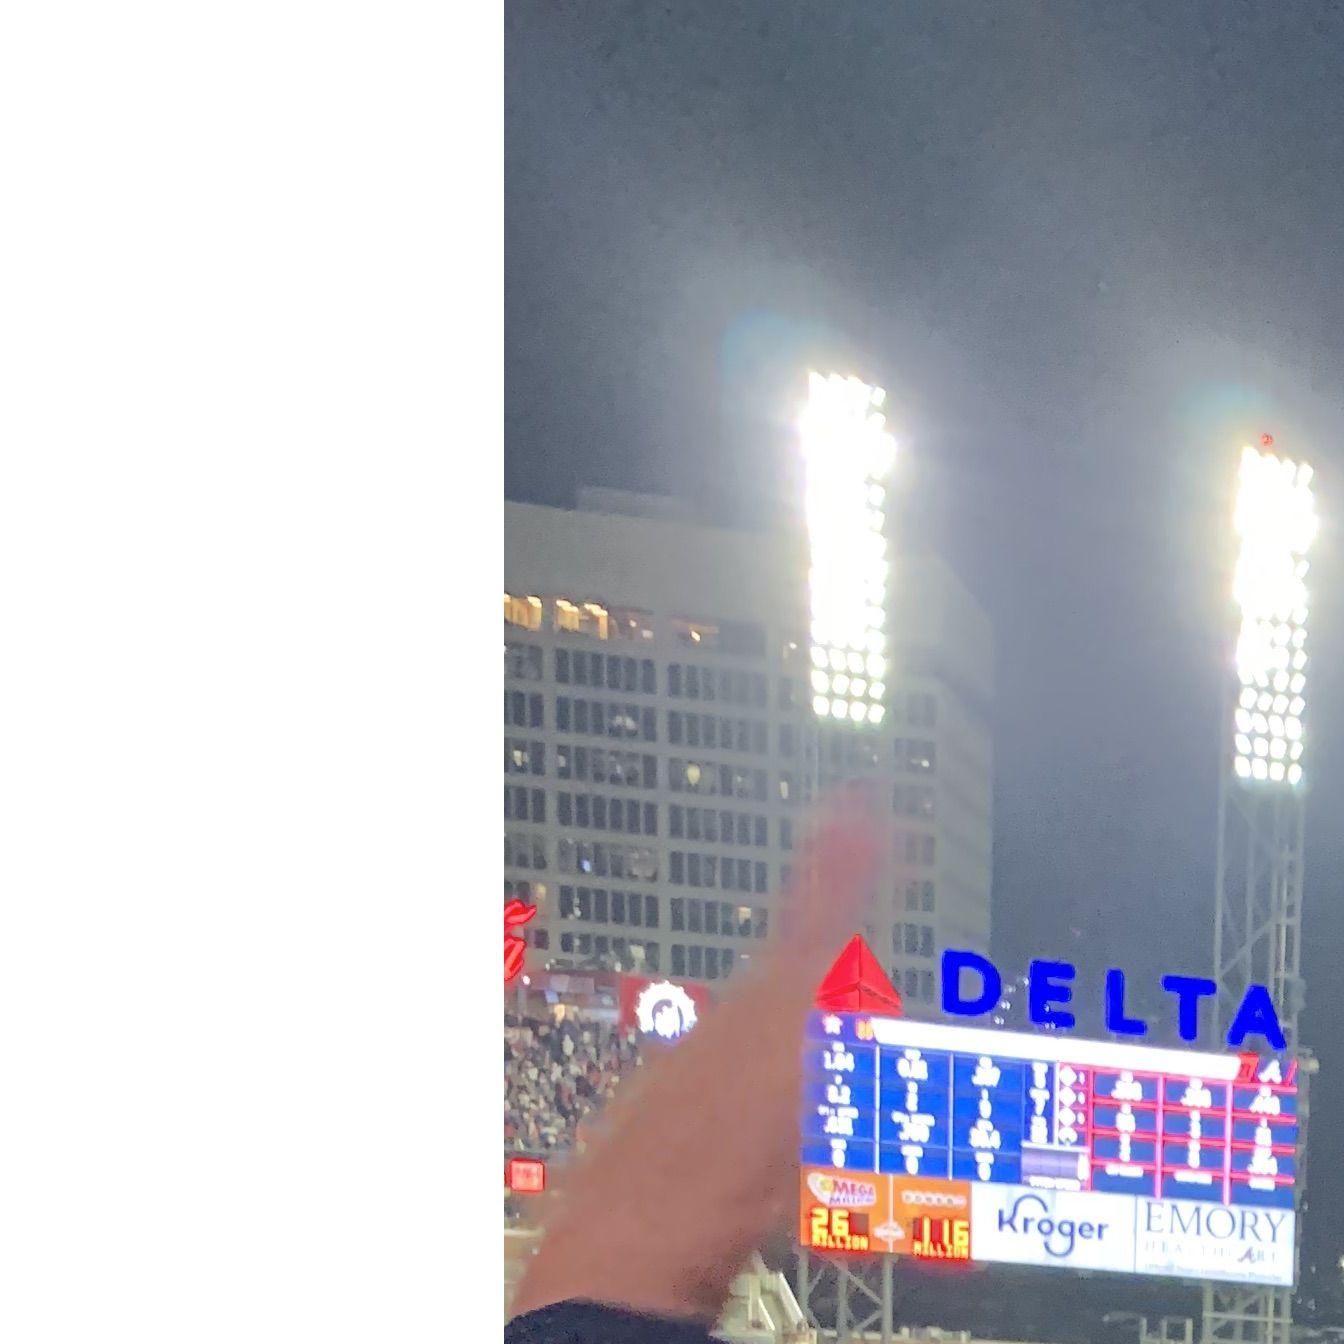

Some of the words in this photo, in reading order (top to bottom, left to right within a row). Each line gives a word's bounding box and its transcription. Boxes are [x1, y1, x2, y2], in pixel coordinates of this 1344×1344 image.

[941, 949, 1288, 1050] DELTA
[811, 1207, 850, 1238] 26
[998, 1194, 1110, 1258] Kroger
[1145, 1200, 1287, 1244] EMORY
